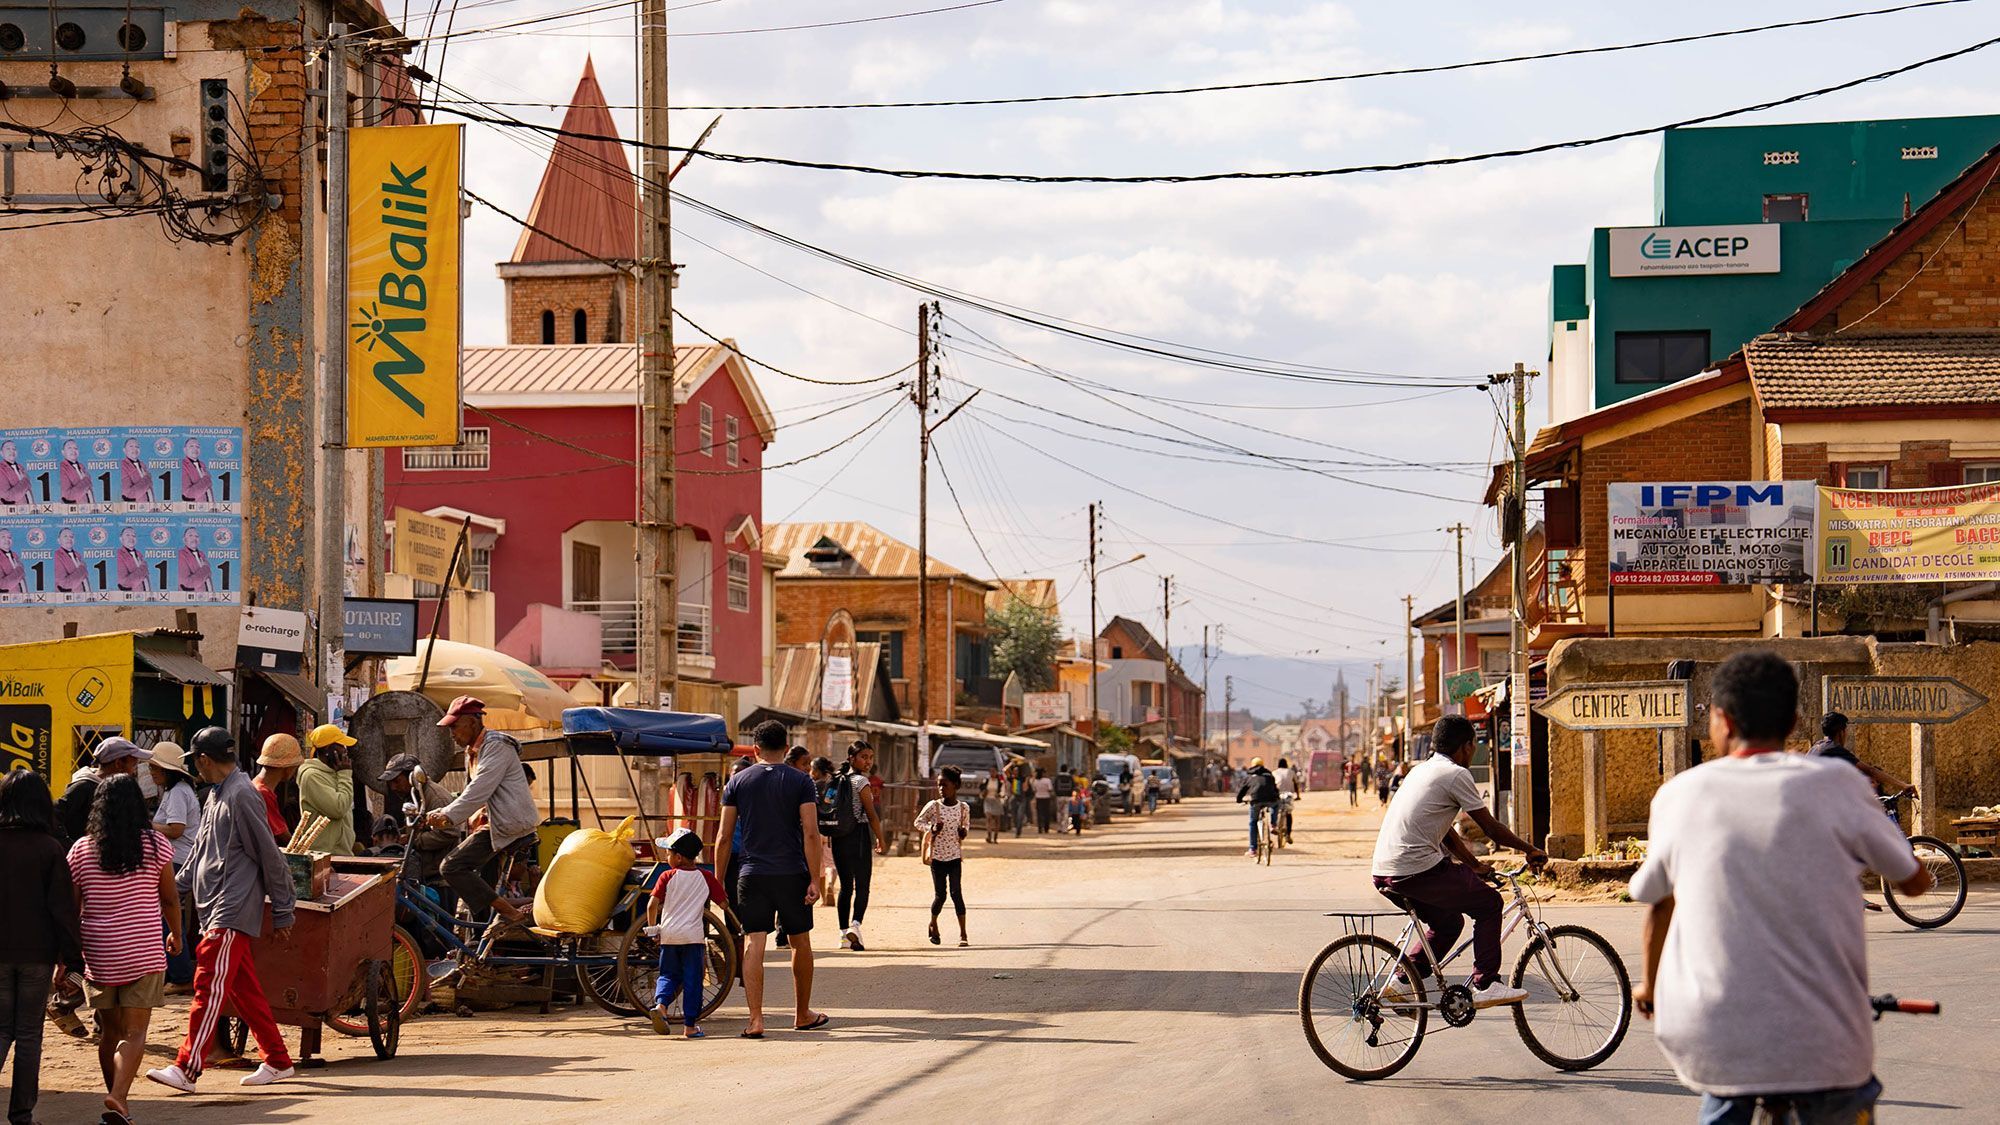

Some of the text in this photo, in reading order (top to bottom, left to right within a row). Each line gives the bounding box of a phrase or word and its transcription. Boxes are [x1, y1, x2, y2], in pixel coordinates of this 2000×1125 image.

[1675, 237, 1749, 258] ACEP
[27, 462, 58, 471] MICHEL
[88, 462, 119, 470] MICHEL
[148, 461, 180, 469] MICHEL
[208, 461, 239, 470] MICHEL
[37, 472, 50, 502] 1
[98, 472, 111, 502] 1
[158, 471, 171, 500] 1
[218, 472, 230, 500] 1
[1641, 485, 1784, 507] IFPM
[1876, 491, 1917, 508] PRIVE
[1920, 488, 1967, 506] COURS
[1613, 515, 1659, 525] Formation
[1828, 519, 1888, 530] MISOKATRA
[1890, 519, 1904, 529] NY
[1906, 516, 1967, 528] FISORATANA
[1614, 528, 1696, 540] MECANIQUE
[1700, 528, 1716, 539] ET
[1869, 531, 1912, 547] BEPC
[1955, 527, 2000, 544] BACC
[22, 552, 53, 560] MICHEL
[84, 550, 115, 558] MICHEL
[145, 550, 176, 558] MICHEL
[208, 550, 240, 559] MICHEL
[1640, 544, 1782, 556] AUTOMOBILE, MOTO
[1832, 544, 1846, 566] 11
[1634, 558, 1791, 570] APPAREIL DIAGNOSTIC
[1852, 555, 1919, 569] CANDIDAT
[1922, 554, 1974, 567] D'ECOLE
[31, 561, 44, 591] 1
[94, 560, 107, 590] 1
[155, 560, 167, 590] 1
[218, 560, 230, 590] 1
[1614, 574, 1629, 582] 034
[1630, 574, 1637, 582] 12
[1638, 574, 1652, 582] 224
[1652, 574, 1662, 582] 82
[1681, 574, 1690, 582] 24
[1691, 574, 1704, 582] 401
[1704, 574, 1714, 582] 57
[1890, 572, 1940, 580] AMBOHIMENA
[343, 610, 402, 626] OTAIRE
[245, 623, 300, 638] e-recharge
[358, 632, 372, 640] 80
[450, 668, 476, 678] 4G
[1572, 693, 1681, 718] CENTRE VILLE
[1832, 685, 1948, 711] ANTANANARIVO
[38, 728, 49, 770] Money
